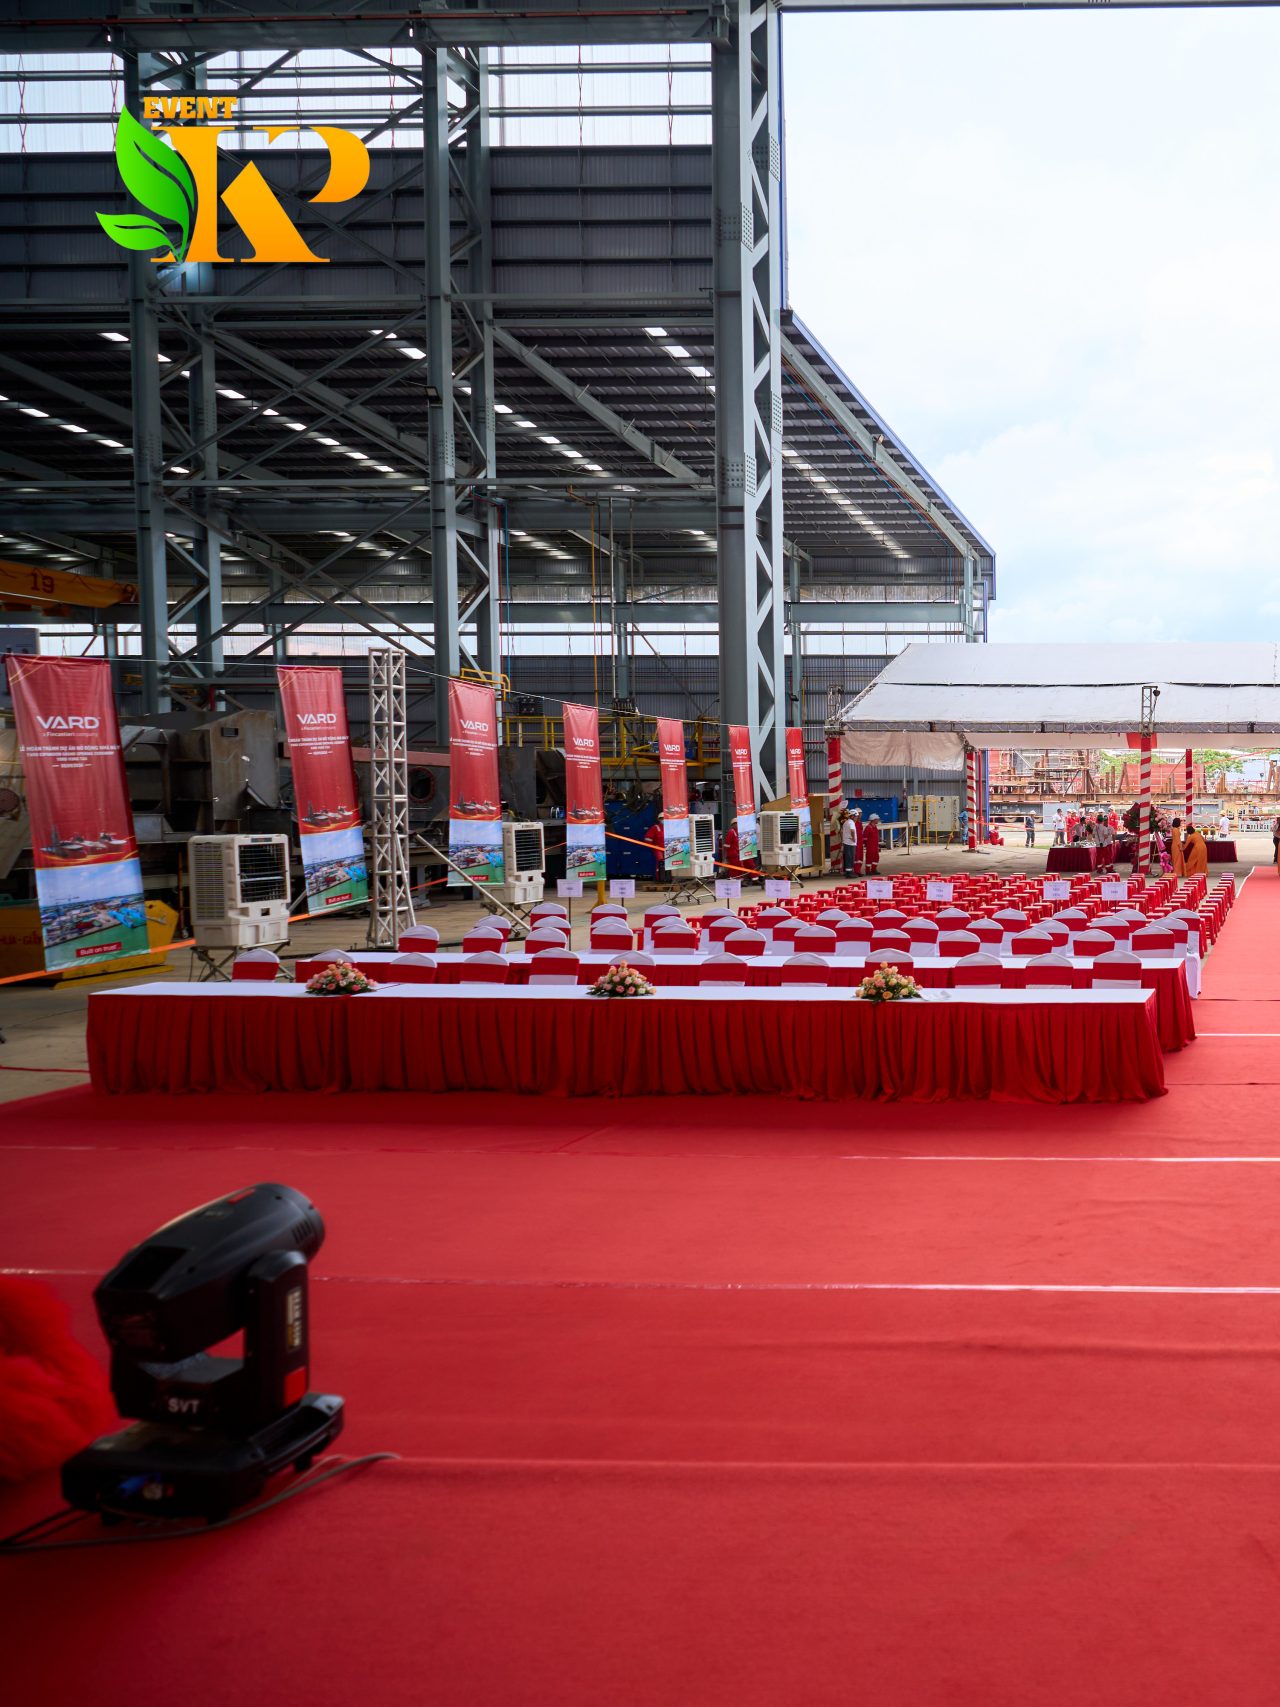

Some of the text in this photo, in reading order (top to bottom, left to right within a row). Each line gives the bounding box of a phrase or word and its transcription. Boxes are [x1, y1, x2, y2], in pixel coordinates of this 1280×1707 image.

[31, 568, 55, 594] 19
[36, 715, 99, 729] VARD
[296, 713, 337, 725] VARD
[460, 719, 489, 732] VARD
[572, 737, 595, 748] VARD
[663, 743, 681, 752] VARD
[168, 1397, 200, 1414] SVT
